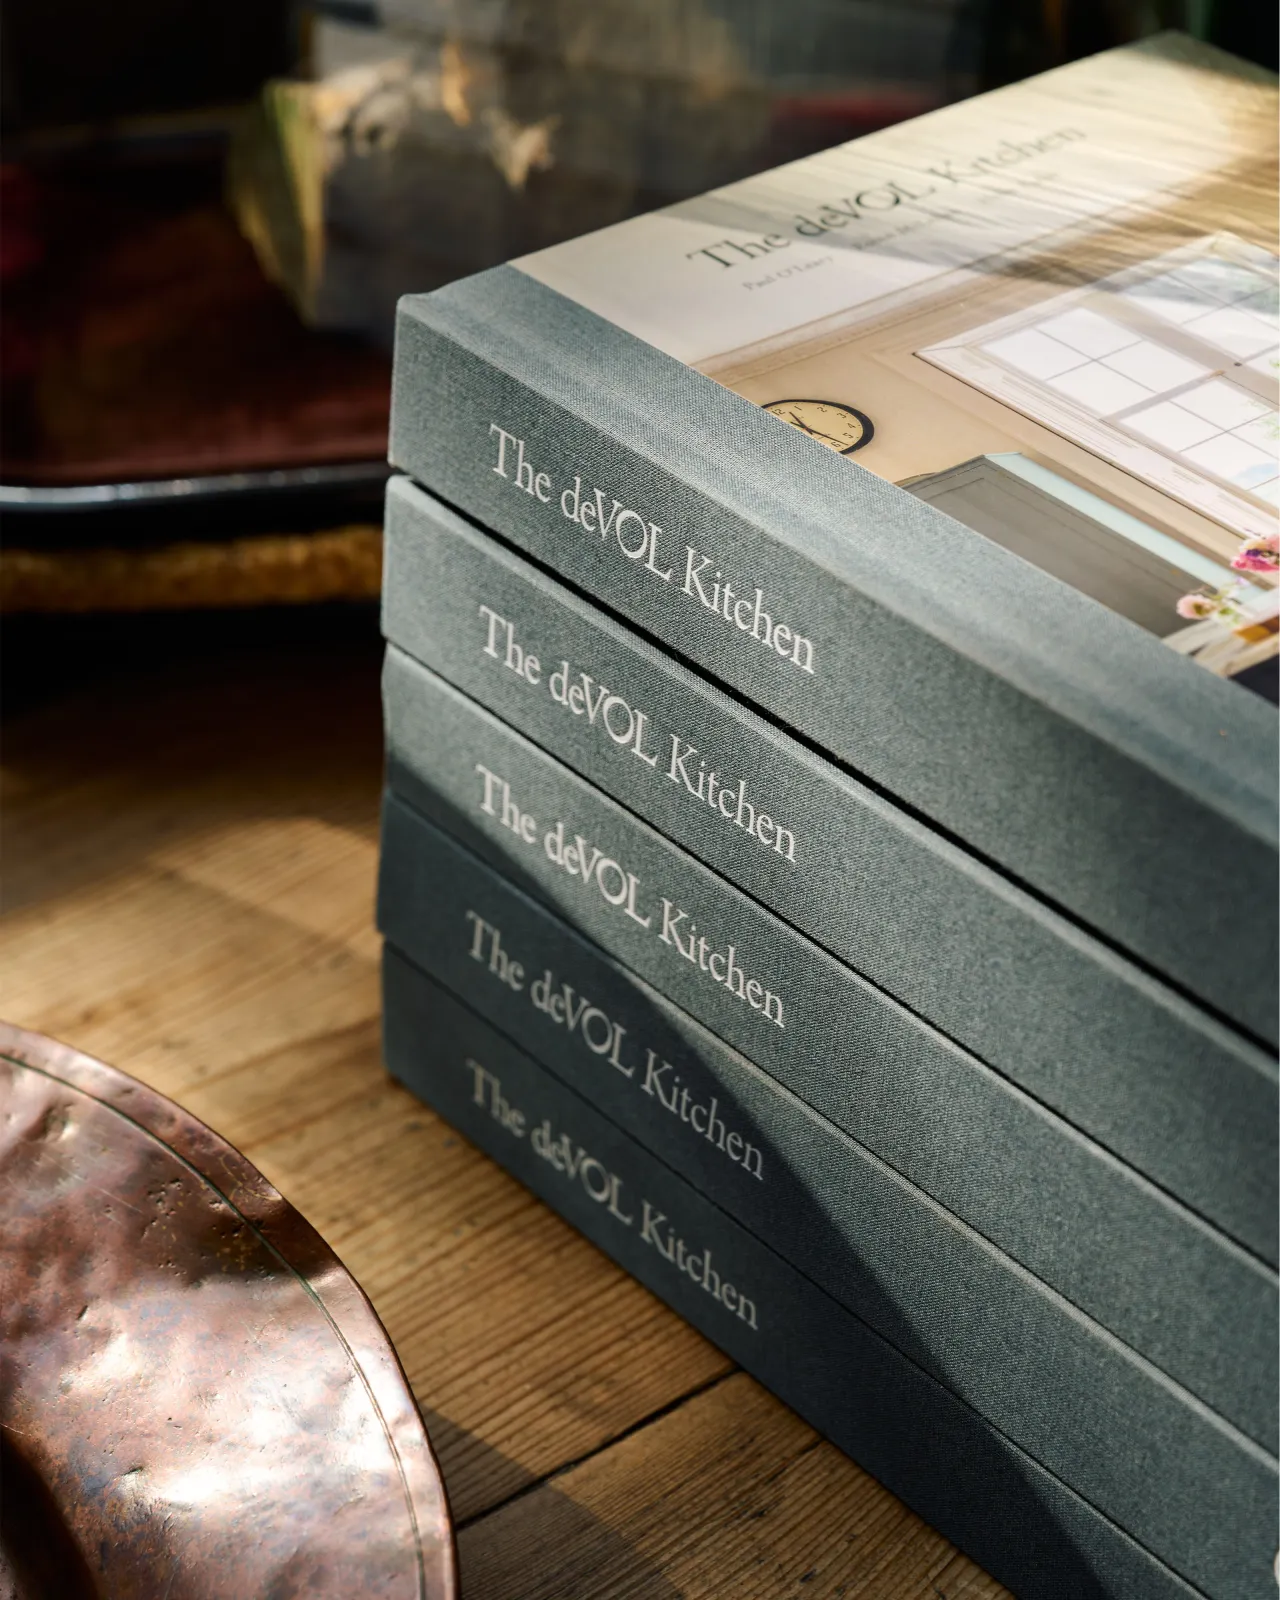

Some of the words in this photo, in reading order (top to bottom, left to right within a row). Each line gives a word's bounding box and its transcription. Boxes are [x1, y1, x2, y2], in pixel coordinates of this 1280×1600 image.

[686, 232, 792, 268] The
[795, 181, 937, 238] deVOL
[928, 124, 1087, 184] Kitchen
[488, 423, 551, 503] The
[560, 476, 674, 582] deVOL
[680, 545, 815, 675] Kitchen
[479, 605, 541, 685] The
[550, 661, 658, 767] deVOL
[666, 733, 797, 863] Kitchen
[475, 763, 537, 844] The
[544, 822, 651, 928] deVOL
[658, 898, 785, 1028] Kitchen
[465, 910, 525, 991] The
[530, 970, 635, 1078] deVOL
[640, 1048, 763, 1181] Kitchen
[465, 1058, 526, 1138] The
[530, 1120, 633, 1226] deVOL
[639, 1201, 759, 1331] Kitchen
